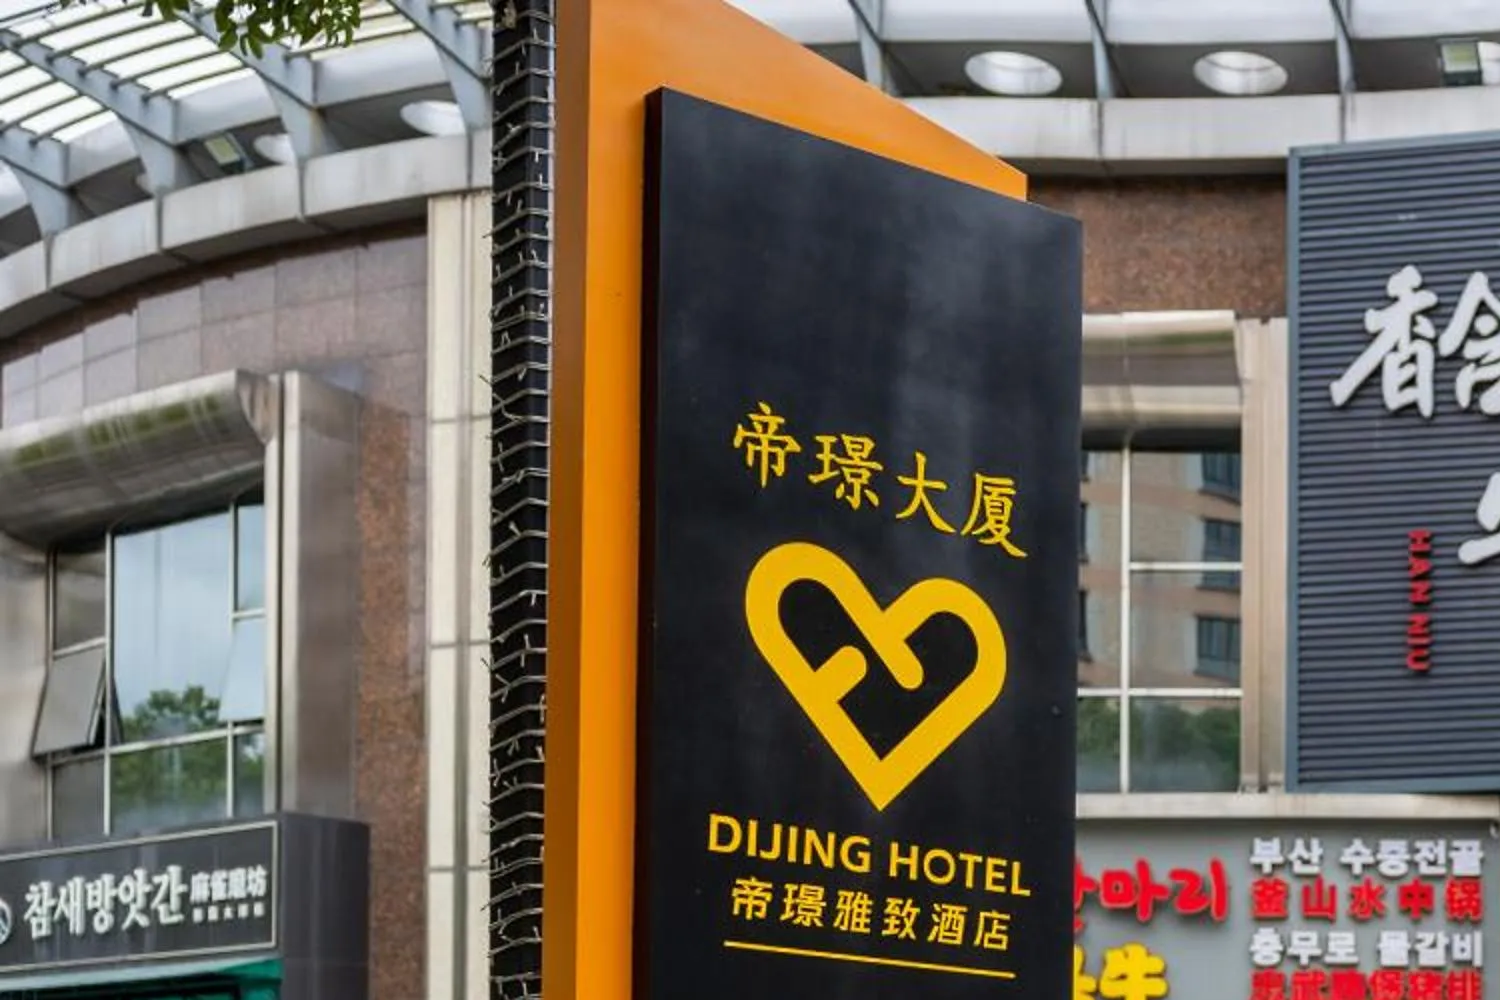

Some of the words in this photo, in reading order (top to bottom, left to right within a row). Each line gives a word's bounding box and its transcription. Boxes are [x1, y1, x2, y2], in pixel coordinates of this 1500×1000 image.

[733, 402, 1028, 559] 帝璟大厦
[1408, 528, 1432, 604] HAN
[1406, 613, 1431, 672] NIU
[707, 813, 872, 873] DIJING
[889, 842, 1031, 897] HOTEL
[1250, 837, 1323, 875] 부산
[24, 864, 189, 940] 참새방앗간
[731, 877, 1010, 951] 帝璟雅致酒店
[1074, 857, 1228, 931] 마리
[1250, 927, 1360, 967] 충무로
